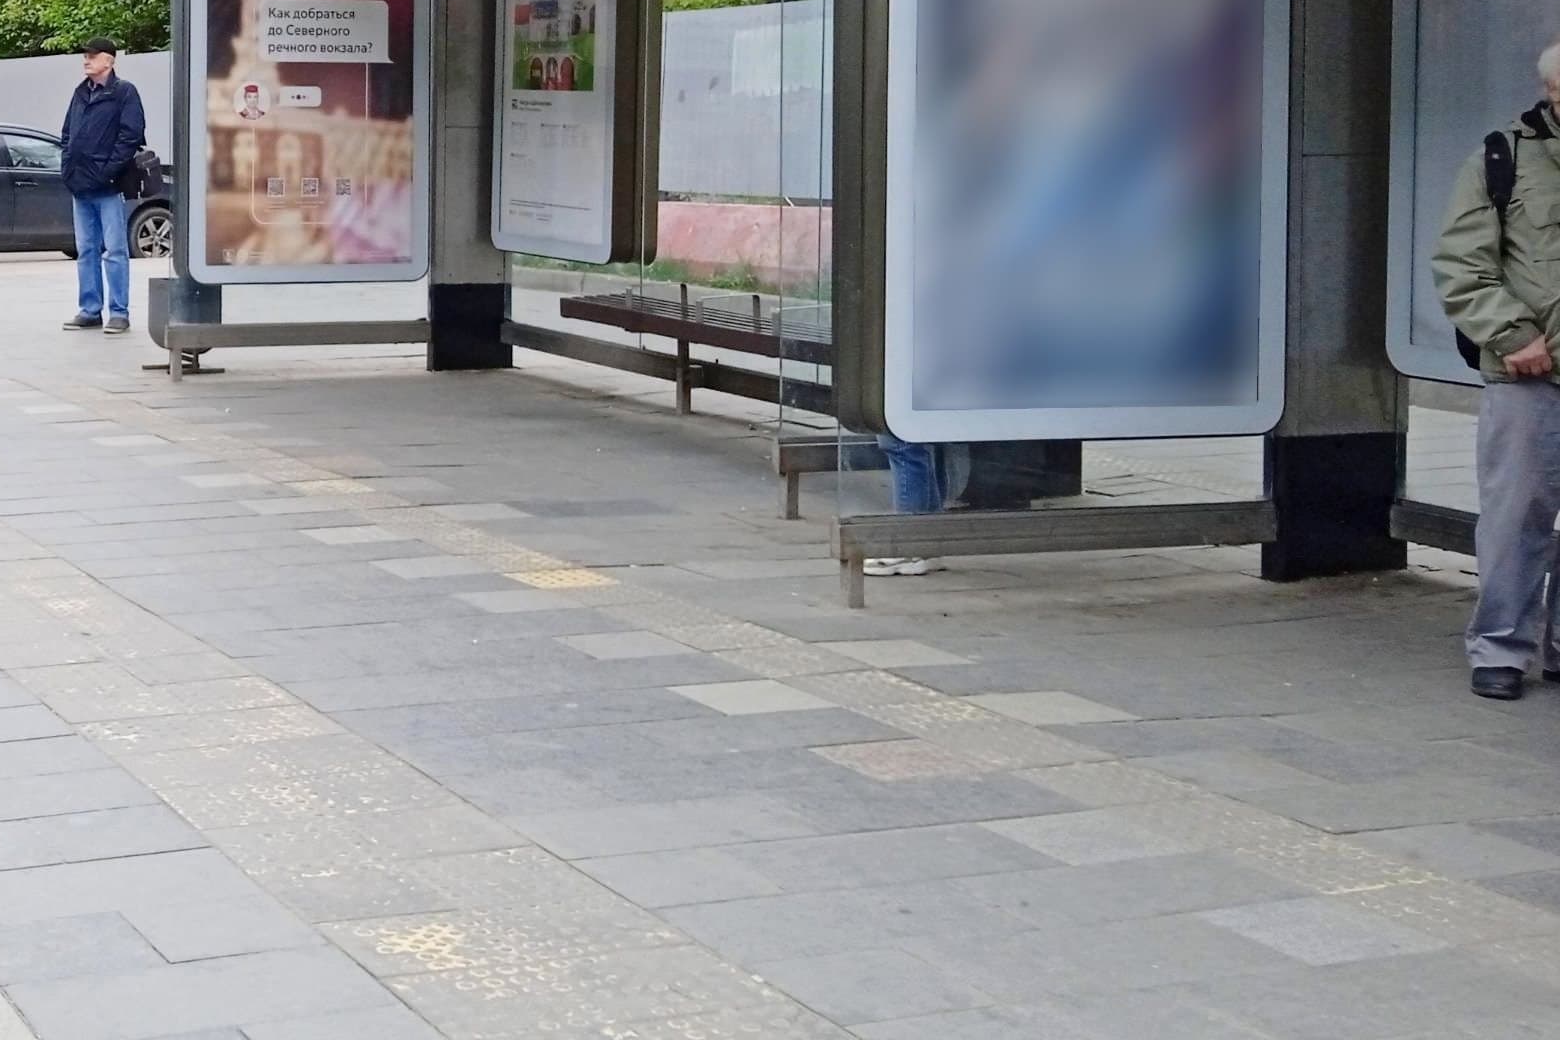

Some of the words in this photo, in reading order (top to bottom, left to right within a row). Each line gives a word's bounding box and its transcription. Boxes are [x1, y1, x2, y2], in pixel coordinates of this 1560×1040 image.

[268, 7, 291, 18] Как
[293, 7, 356, 20] добраться
[267, 26, 283, 36] до
[286, 24, 351, 37] Северного
[267, 43, 317, 55] речного
[320, 42, 373, 53] вокзала?
